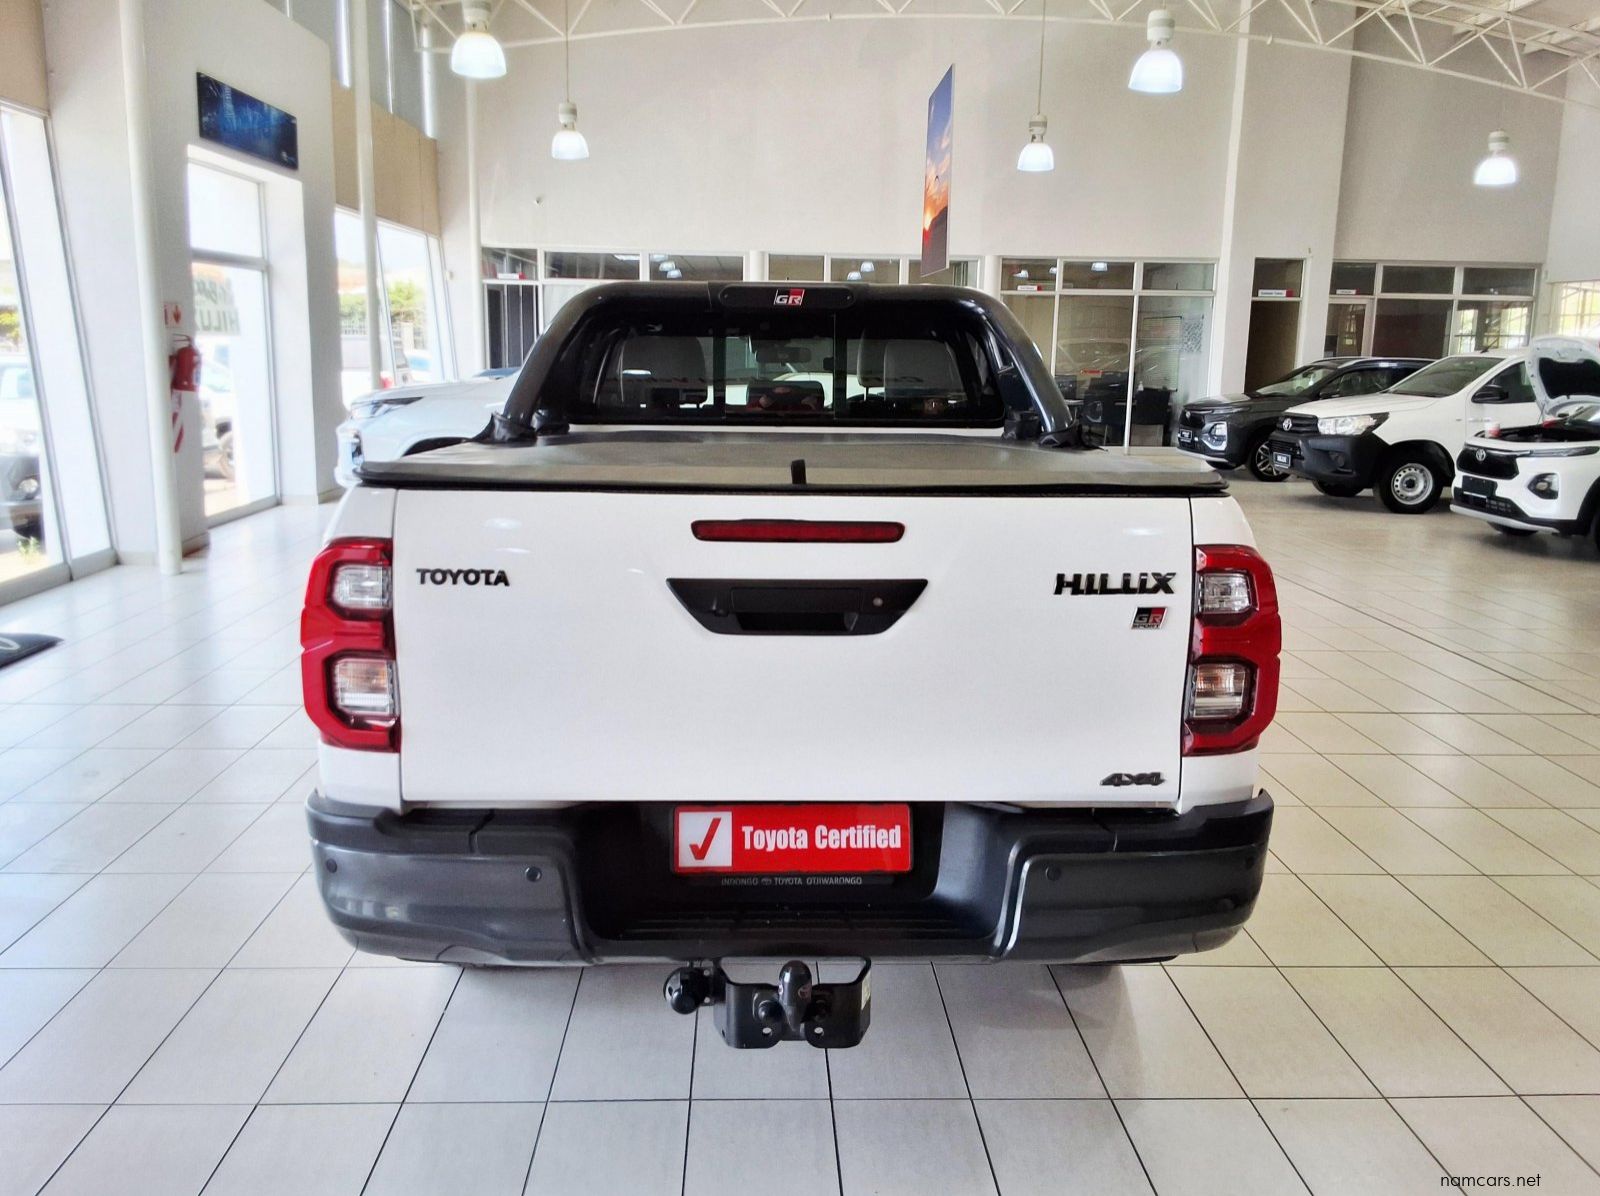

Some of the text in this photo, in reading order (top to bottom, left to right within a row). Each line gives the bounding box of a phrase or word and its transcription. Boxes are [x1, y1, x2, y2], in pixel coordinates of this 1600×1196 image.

[775, 294, 802, 305] GR
[416, 568, 510, 587] TOYOTA
[1053, 572, 1177, 595] HILUX
[1134, 613, 1163, 624] GR
[742, 825, 901, 852] Toyota Certified
[721, 877, 863, 886] INDONGO TOYOTA OTJIWARONGO
